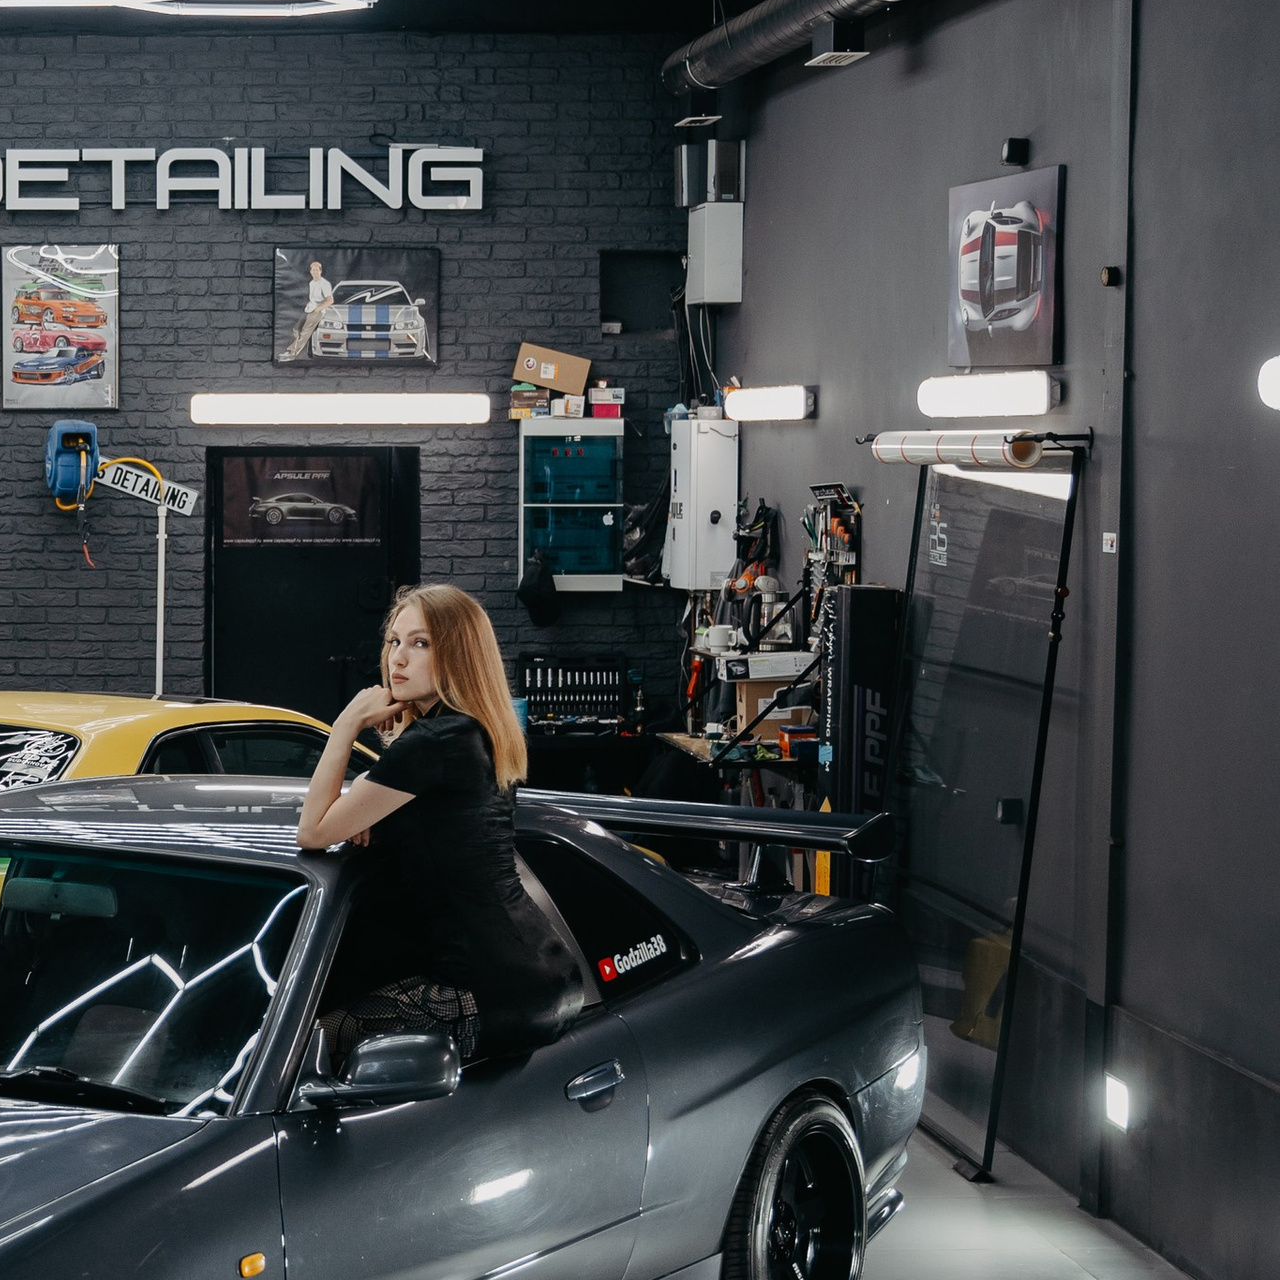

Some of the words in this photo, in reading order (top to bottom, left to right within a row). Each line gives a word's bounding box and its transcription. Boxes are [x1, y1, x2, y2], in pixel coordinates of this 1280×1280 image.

[110, 466, 189, 509] DETAILING
[825, 667, 833, 738] WRAPPING
[613, 933, 667, 974] Godzilla38
